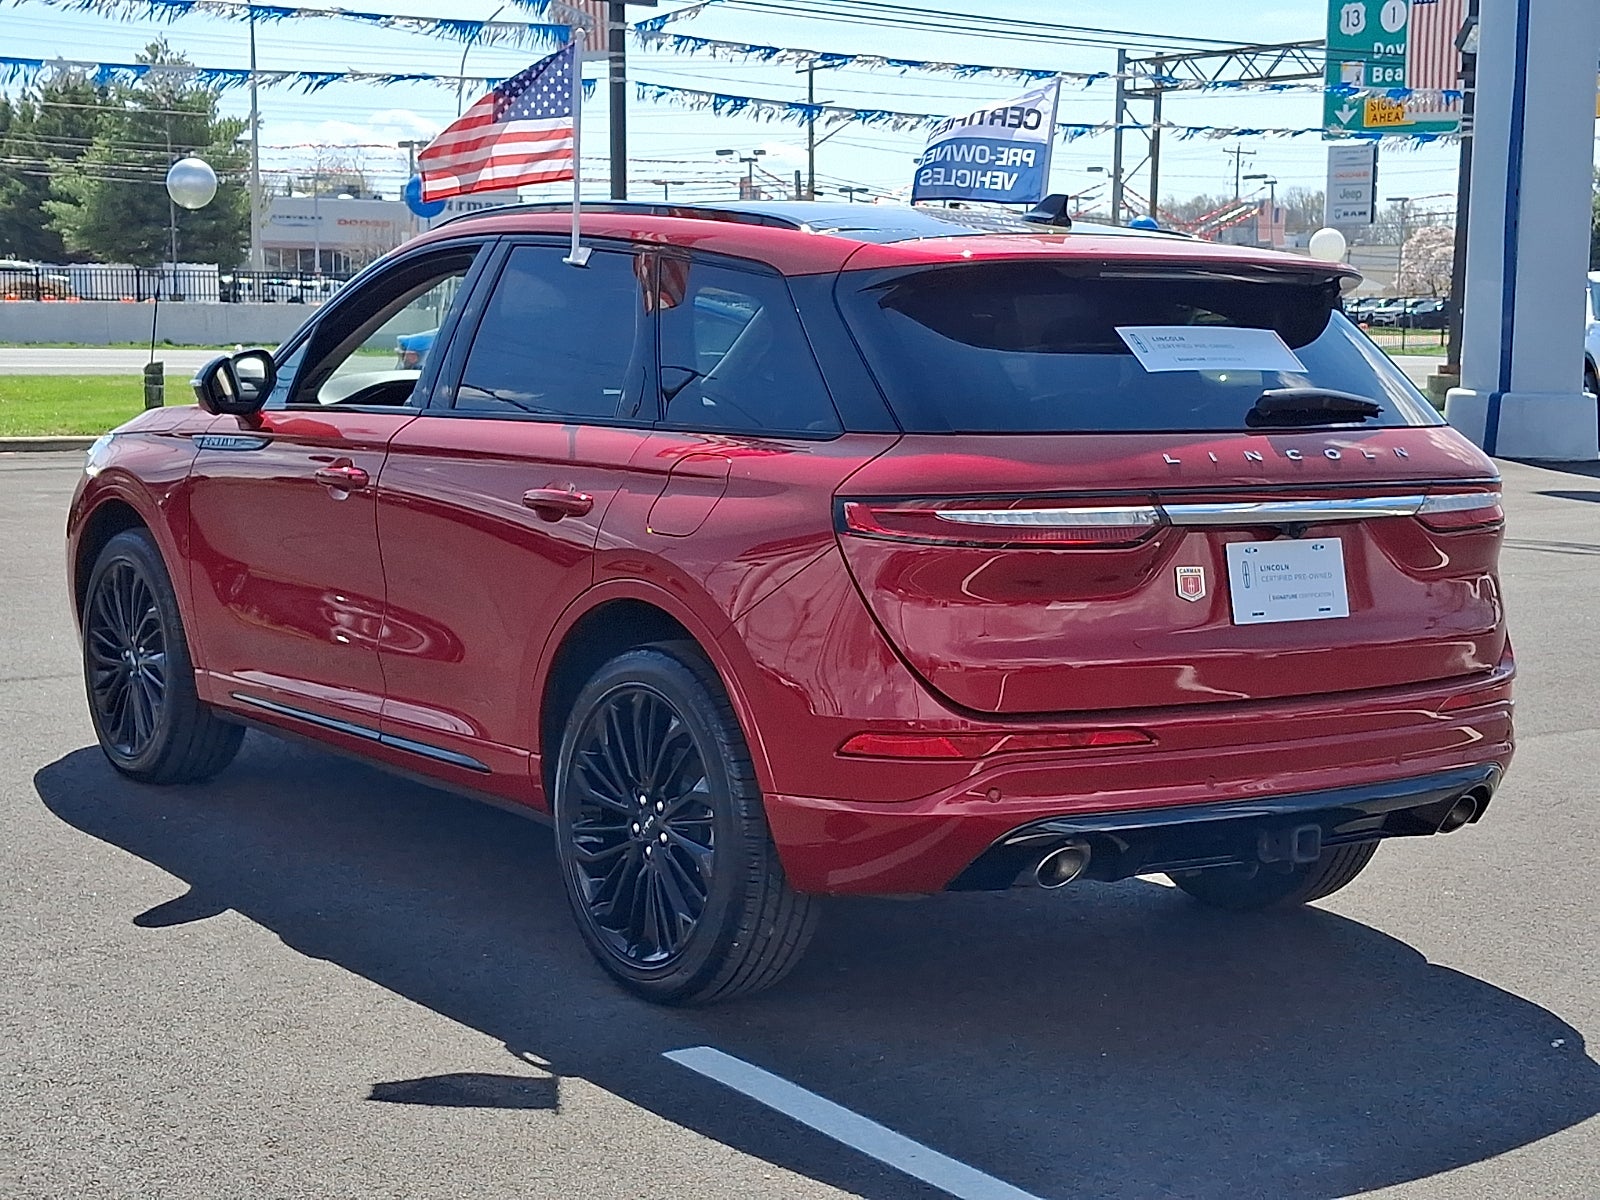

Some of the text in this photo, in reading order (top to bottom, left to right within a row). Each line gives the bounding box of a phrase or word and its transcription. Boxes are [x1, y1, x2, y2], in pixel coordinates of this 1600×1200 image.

[1345, 9, 1361, 27] 13
[1391, 6, 1397, 24] 1
[1372, 66, 1404, 83] Bea
[1339, 188, 1362, 201] Jeep
[1162, 446, 1410, 465] LINCOLN
[1260, 564, 1289, 572] LINCOLN
[1261, 574, 1293, 582] CERTIFIED
